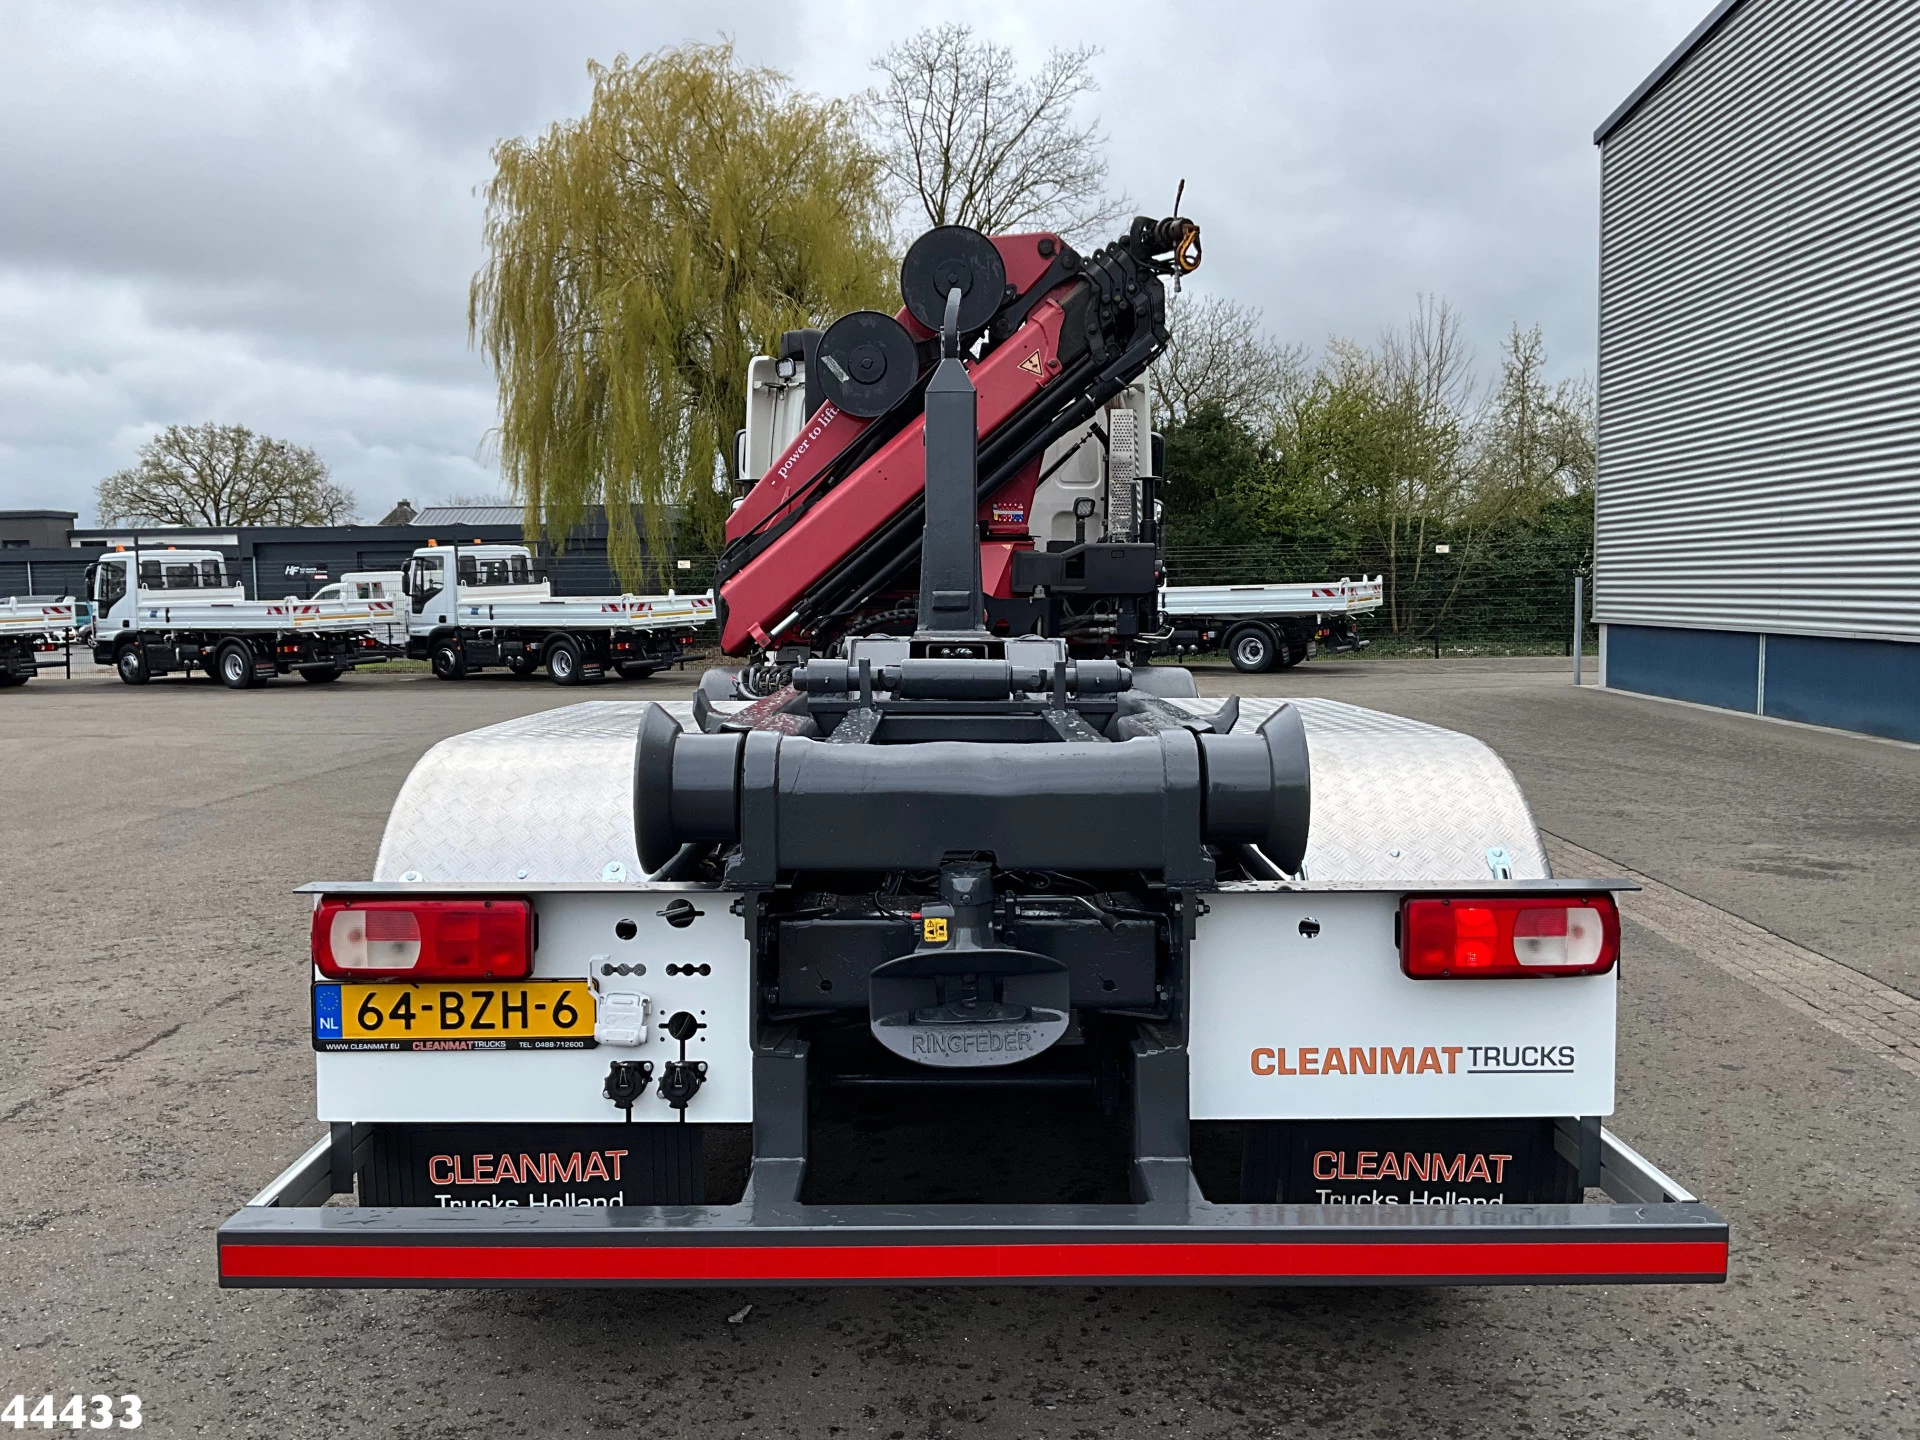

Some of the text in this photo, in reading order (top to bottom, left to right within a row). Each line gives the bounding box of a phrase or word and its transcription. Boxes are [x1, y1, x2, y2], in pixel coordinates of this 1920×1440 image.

[777, 439, 810, 479] power
[808, 426, 822, 440] to
[319, 1017, 339, 1030] NL
[357, 990, 579, 1031] 64-BZH-6
[325, 1042, 400, 1050] WWW.CLEANMAT.EU
[412, 1040, 473, 1051] CLEANMAT
[474, 1040, 507, 1050] TRUCKS
[912, 1030, 1033, 1054] RINGFEDER
[1250, 1046, 1575, 1076] CLEANMAT TRUCKS
[429, 1150, 628, 1185] CLEANMAT
[1313, 1151, 1512, 1184] CLEANMAT
